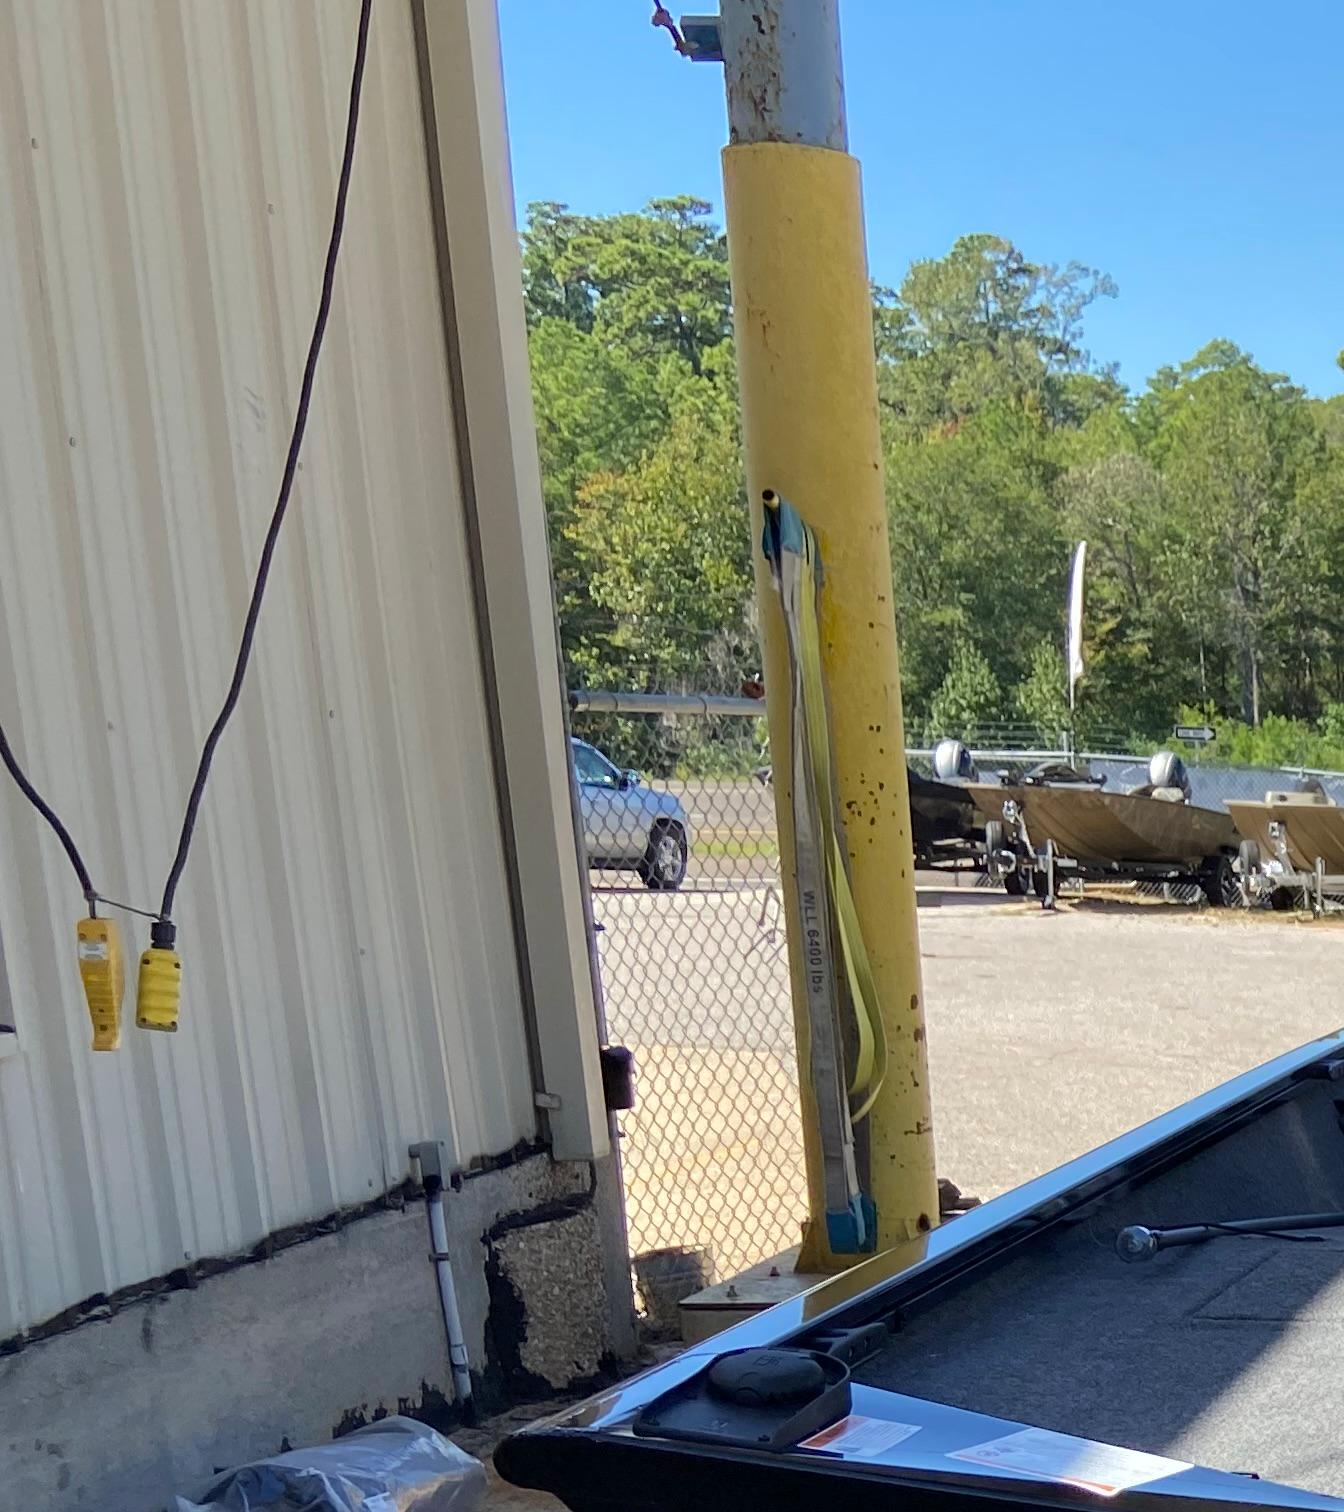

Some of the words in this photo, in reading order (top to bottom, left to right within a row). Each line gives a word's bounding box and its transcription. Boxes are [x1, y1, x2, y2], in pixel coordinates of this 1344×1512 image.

[803, 890, 818, 925] WLL
[807, 929, 822, 965] 6400
[811, 970, 825, 993] lbs
